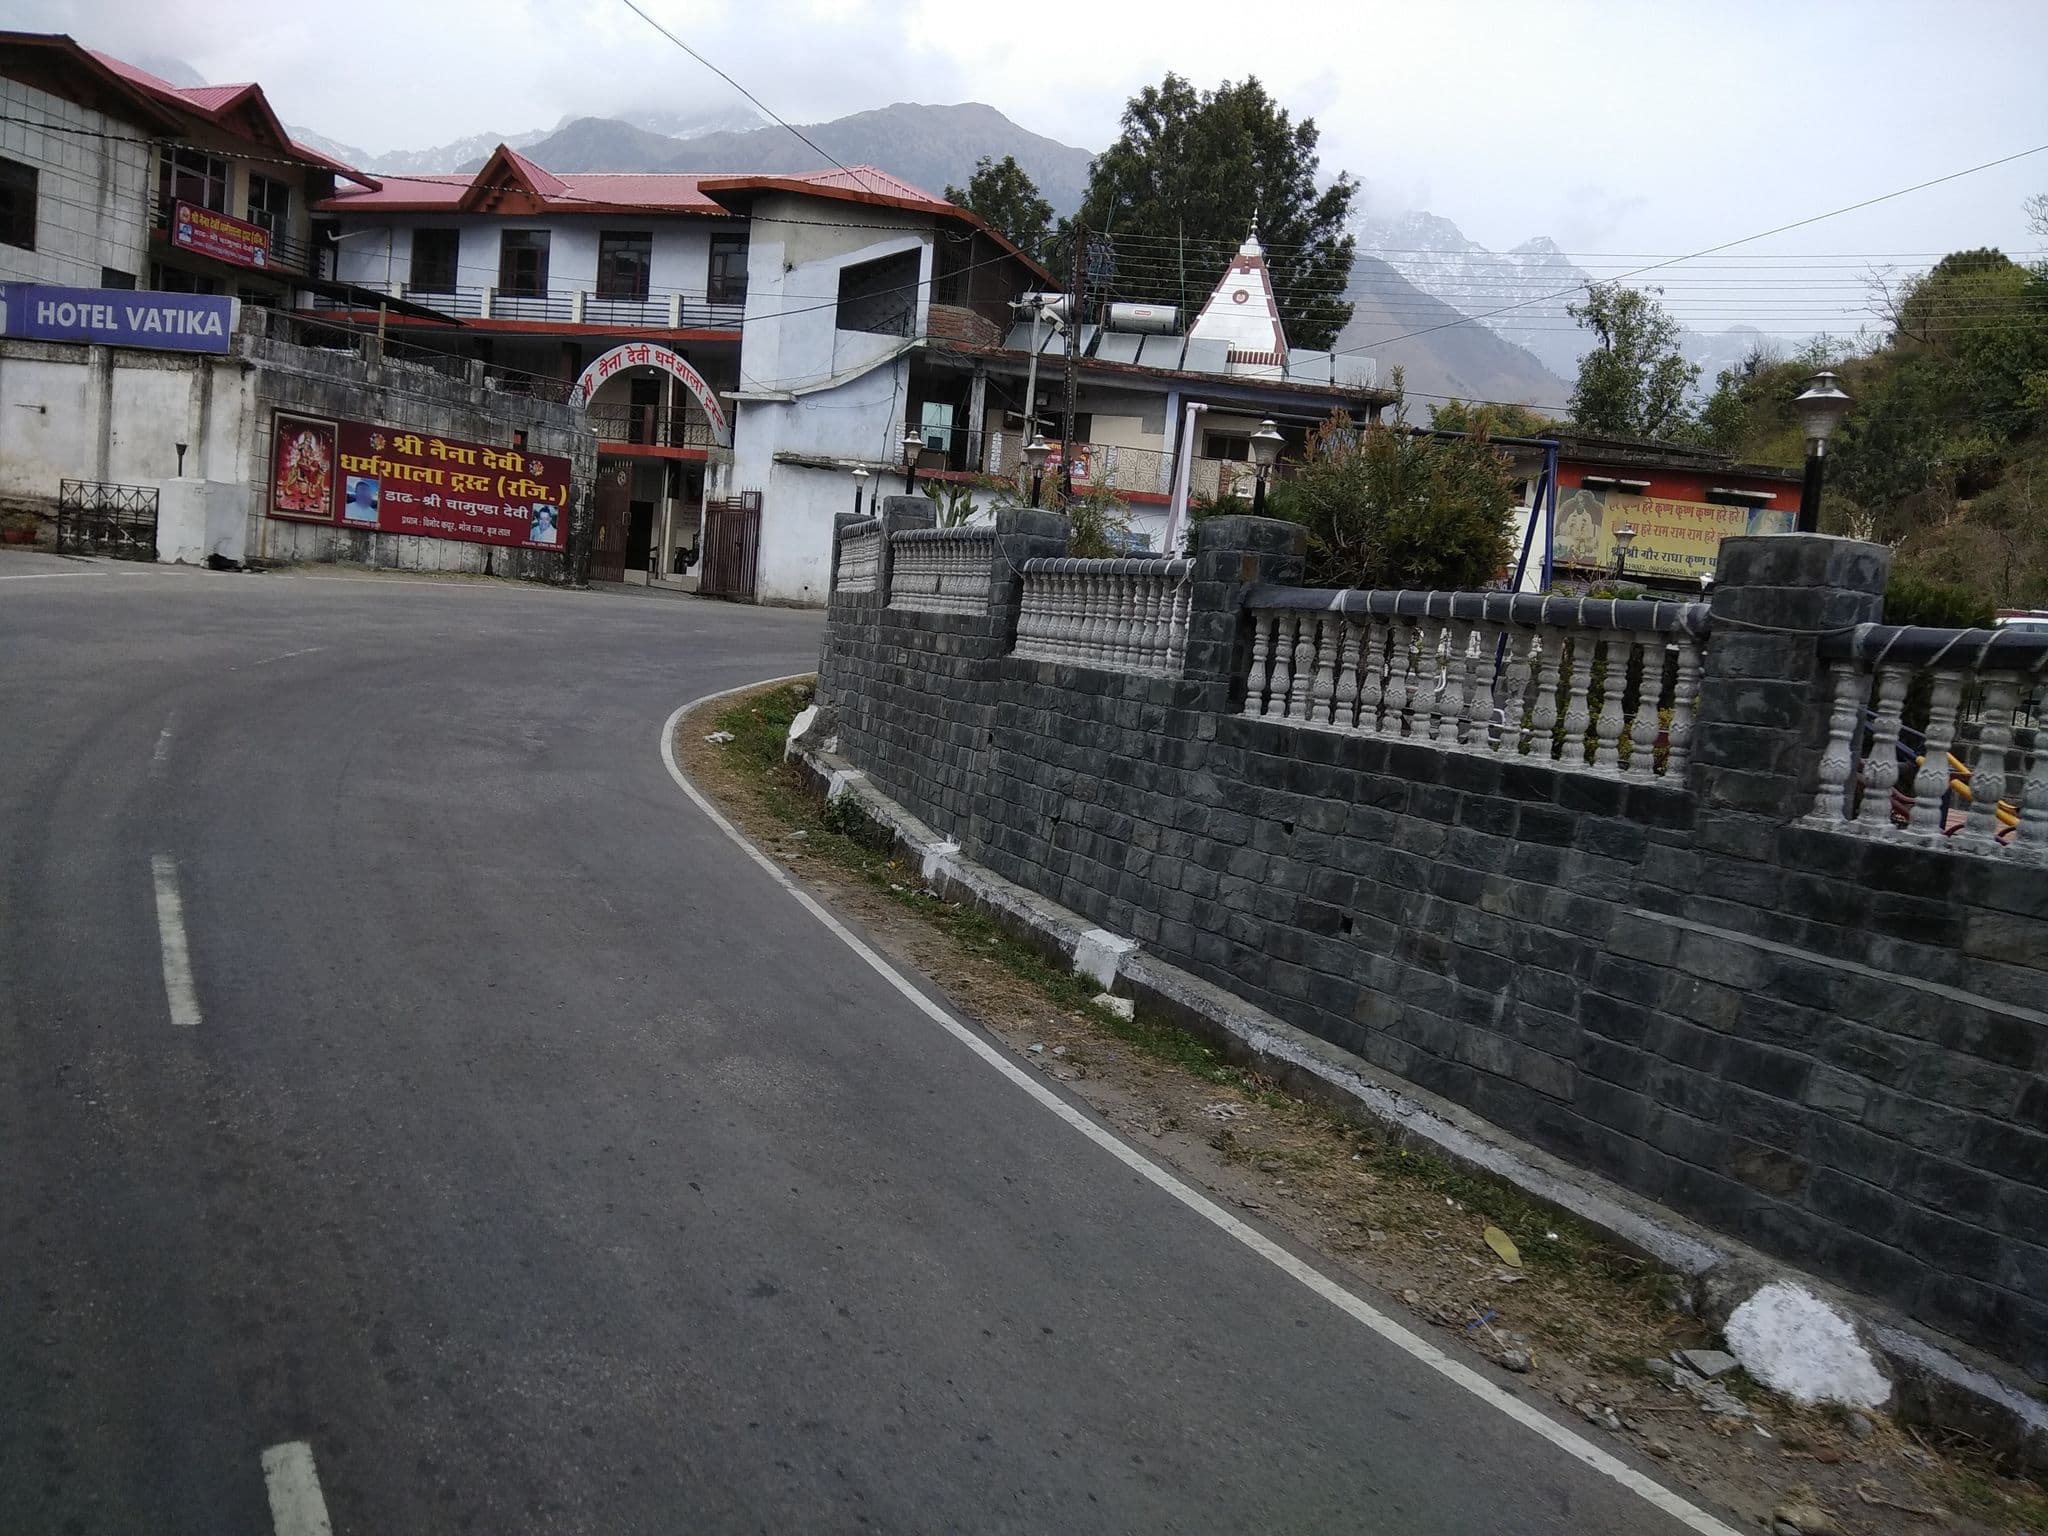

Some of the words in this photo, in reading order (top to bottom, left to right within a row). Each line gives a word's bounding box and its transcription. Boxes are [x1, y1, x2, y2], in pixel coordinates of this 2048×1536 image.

[37, 301, 118, 330] HOTEL
[126, 307, 223, 336] VATIKA
[598, 351, 622, 378] नैना
[625, 344, 650, 364] देवी
[392, 433, 424, 457] श्री
[429, 438, 477, 466] नैना
[482, 447, 526, 473] देवी
[340, 453, 445, 486] धर्मशाला
[450, 471, 492, 494] ट्रस्ट
[497, 475, 568, 506] (रजि.)
[446, 498, 499, 517] चामुण्डा
[502, 502, 530, 520] देवी
[1642, 497, 1653, 515] हरे
[1655, 503, 1674, 518] कृष्ण
[1675, 504, 1694, 520] कृष्ण
[1695, 507, 1715, 522] कृष्ण
[1716, 505, 1727, 523] हरे
[1729, 506, 1740, 524] हरे
[1641, 520, 1653, 537] हरे
[1654, 525, 1670, 537] राम
[1671, 526, 1686, 539] राम
[1687, 528, 1703, 541] राम
[1704, 527, 1716, 544] हरे
[1641, 547, 1659, 560] गौर
[1661, 552, 1682, 563] राधा
[1685, 555, 1706, 568] कृष्ण
